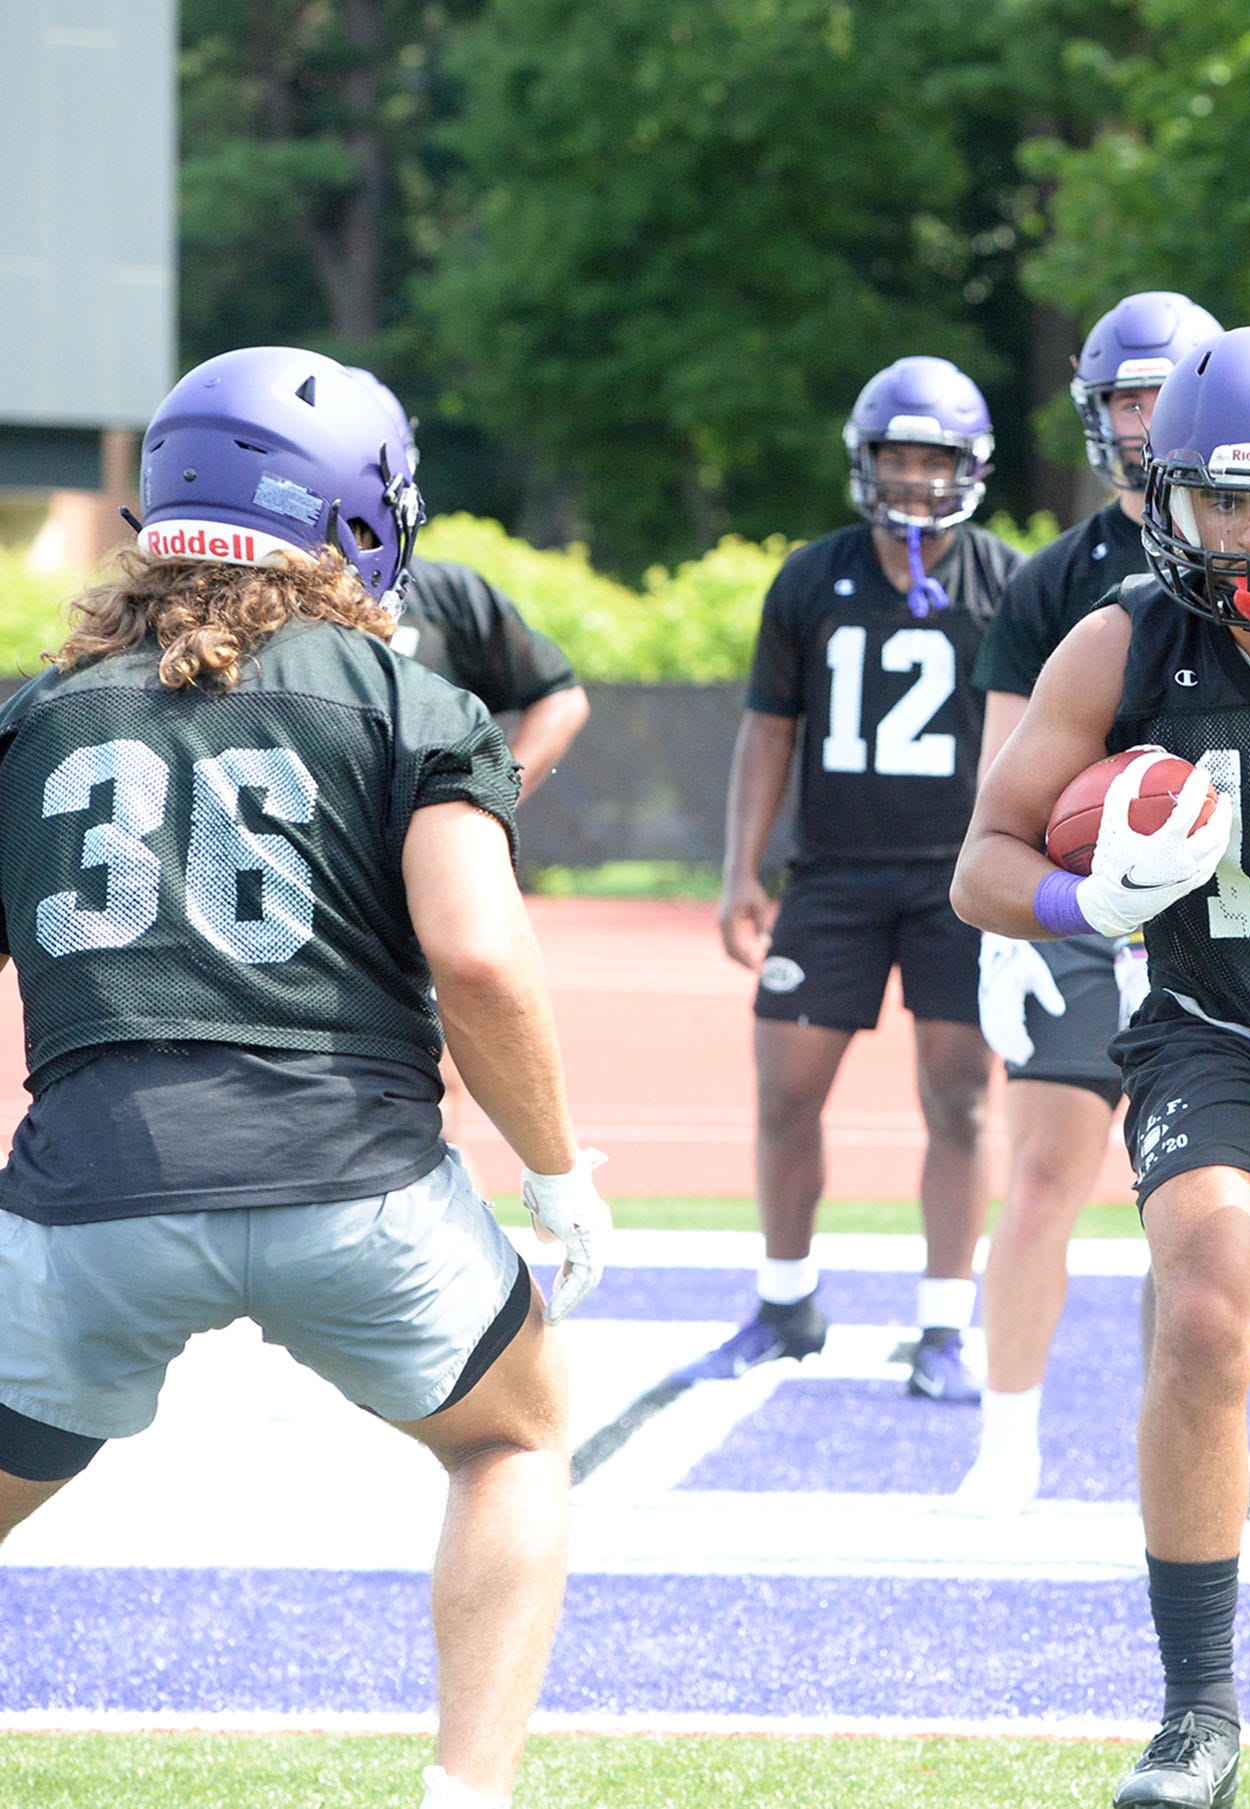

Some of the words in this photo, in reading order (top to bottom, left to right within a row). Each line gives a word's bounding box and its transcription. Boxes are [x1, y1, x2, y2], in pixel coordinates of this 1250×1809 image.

[147, 528, 255, 562] Riddell
[822, 626, 956, 777] 12
[36, 739, 318, 964] 36
